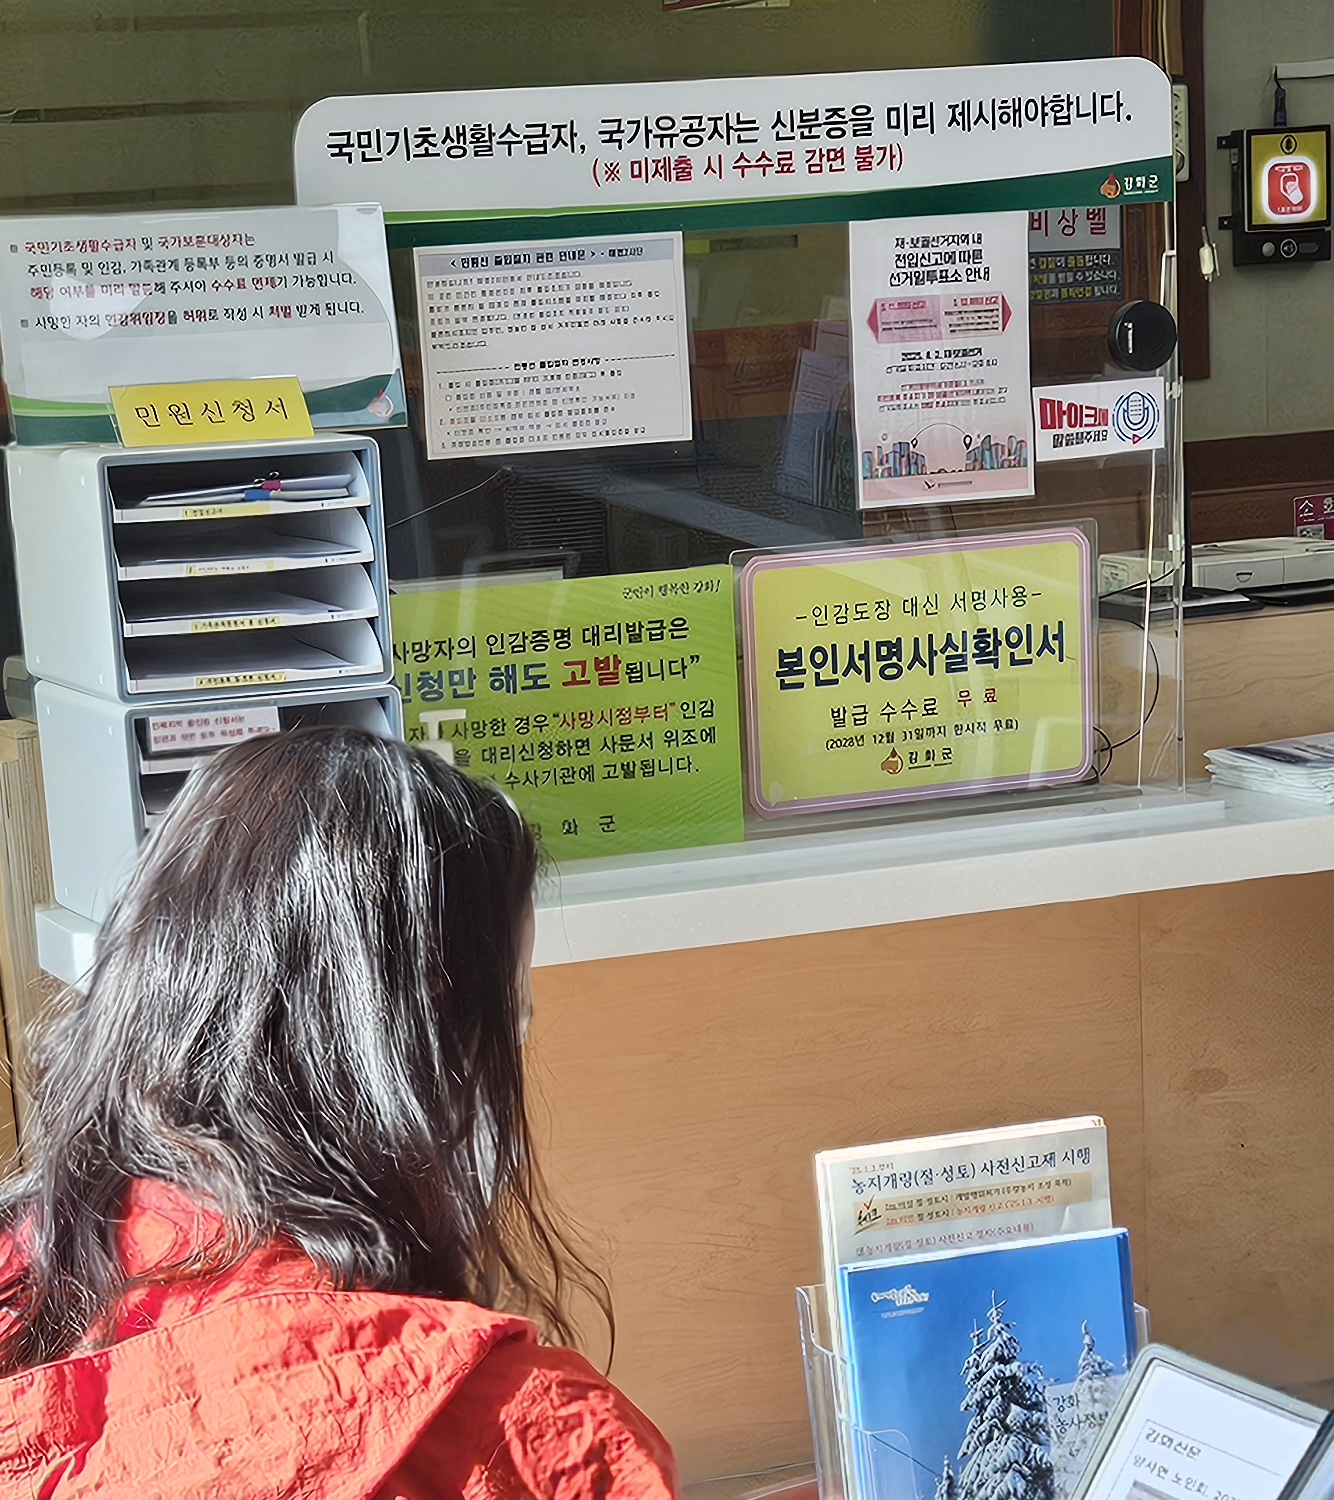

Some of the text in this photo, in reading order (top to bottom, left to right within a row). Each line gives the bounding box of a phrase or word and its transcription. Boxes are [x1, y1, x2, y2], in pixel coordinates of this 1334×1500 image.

[325, 90, 1133, 164] 국민기초생활수급자, 국가유공자는 신분증을 미리 제시해야합니다.
[630, 155, 695, 185] 미제출
[703, 153, 725, 180] 시
[732, 150, 796, 180] 수수료
[804, 146, 846, 177] 감면
[853, 142, 904, 174] 불가)
[322, 250, 335, 265] 시
[894, 248, 983, 269] 전입신고에 따른
[889, 266, 990, 288] 선거일투표소 안내
[252, 304, 264, 320] 시
[134, 397, 290, 428] 민원신청서
[902, 592, 940, 618] 대신
[485, 626, 573, 657] 인감증명
[581, 616, 691, 648] 대리발급은
[775, 620, 1066, 691] 본인서명사실확인서
[489, 661, 551, 695] 해도
[561, 652, 701, 690] 고발됩니다”
[451, 716, 507, 741] 사망한
[514, 713, 550, 736] 경우
[679, 699, 715, 721] 인감
[831, 704, 869, 729] 발급
[879, 697, 939, 723] 수수료
[480, 738, 592, 765] 대리신청하면
[599, 732, 655, 754] 사문서
[663, 726, 717, 749] 위조에
[504, 755, 701, 790] 수사기관에 고발됩니다.
[851, 1147, 1091, 1195] 농지개량(절·성토) 사전신고제 시행
[1052, 1393, 1081, 1413] 강화
